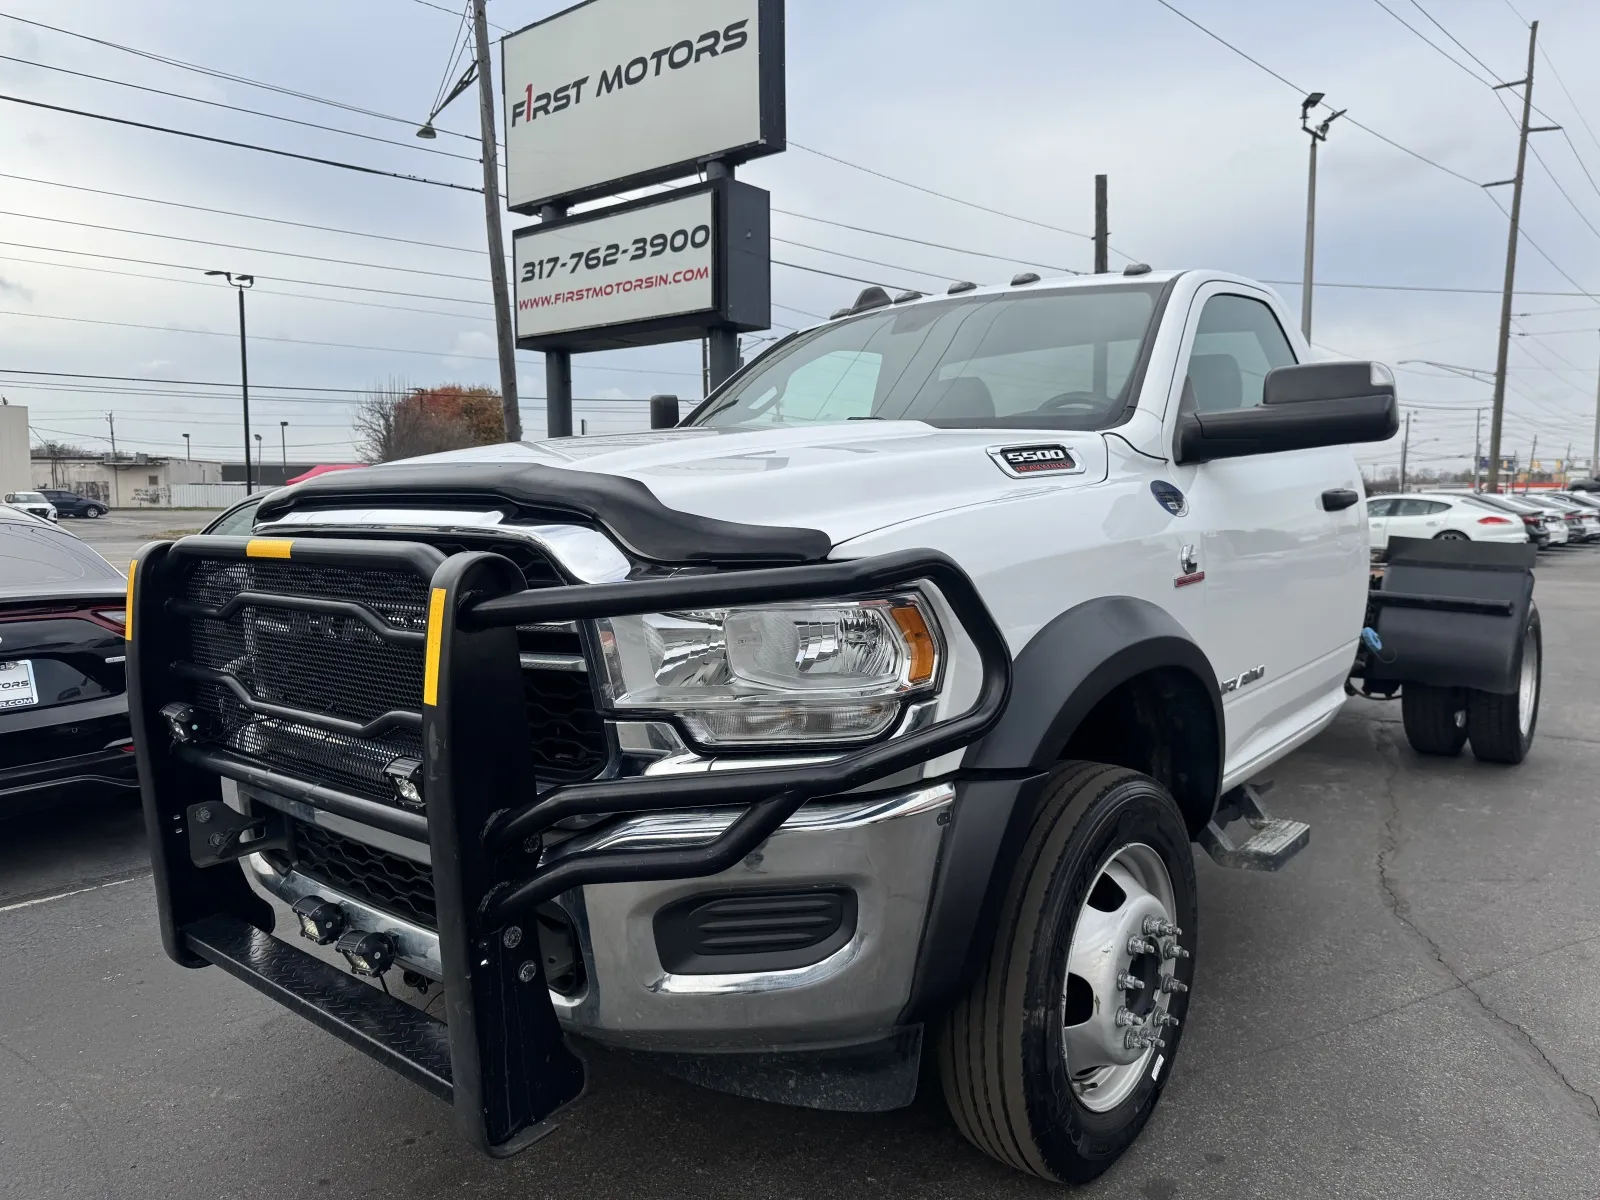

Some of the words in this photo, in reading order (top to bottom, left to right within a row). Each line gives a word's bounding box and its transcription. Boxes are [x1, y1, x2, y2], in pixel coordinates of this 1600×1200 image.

[595, 18, 749, 98] MOTORS
[520, 224, 710, 283] 317-762-3900
[519, 266, 709, 311] WWW.FIRSTMOTORSIN.COM
[1006, 449, 1065, 463] 5500
[0, 680, 29, 689] ORS
